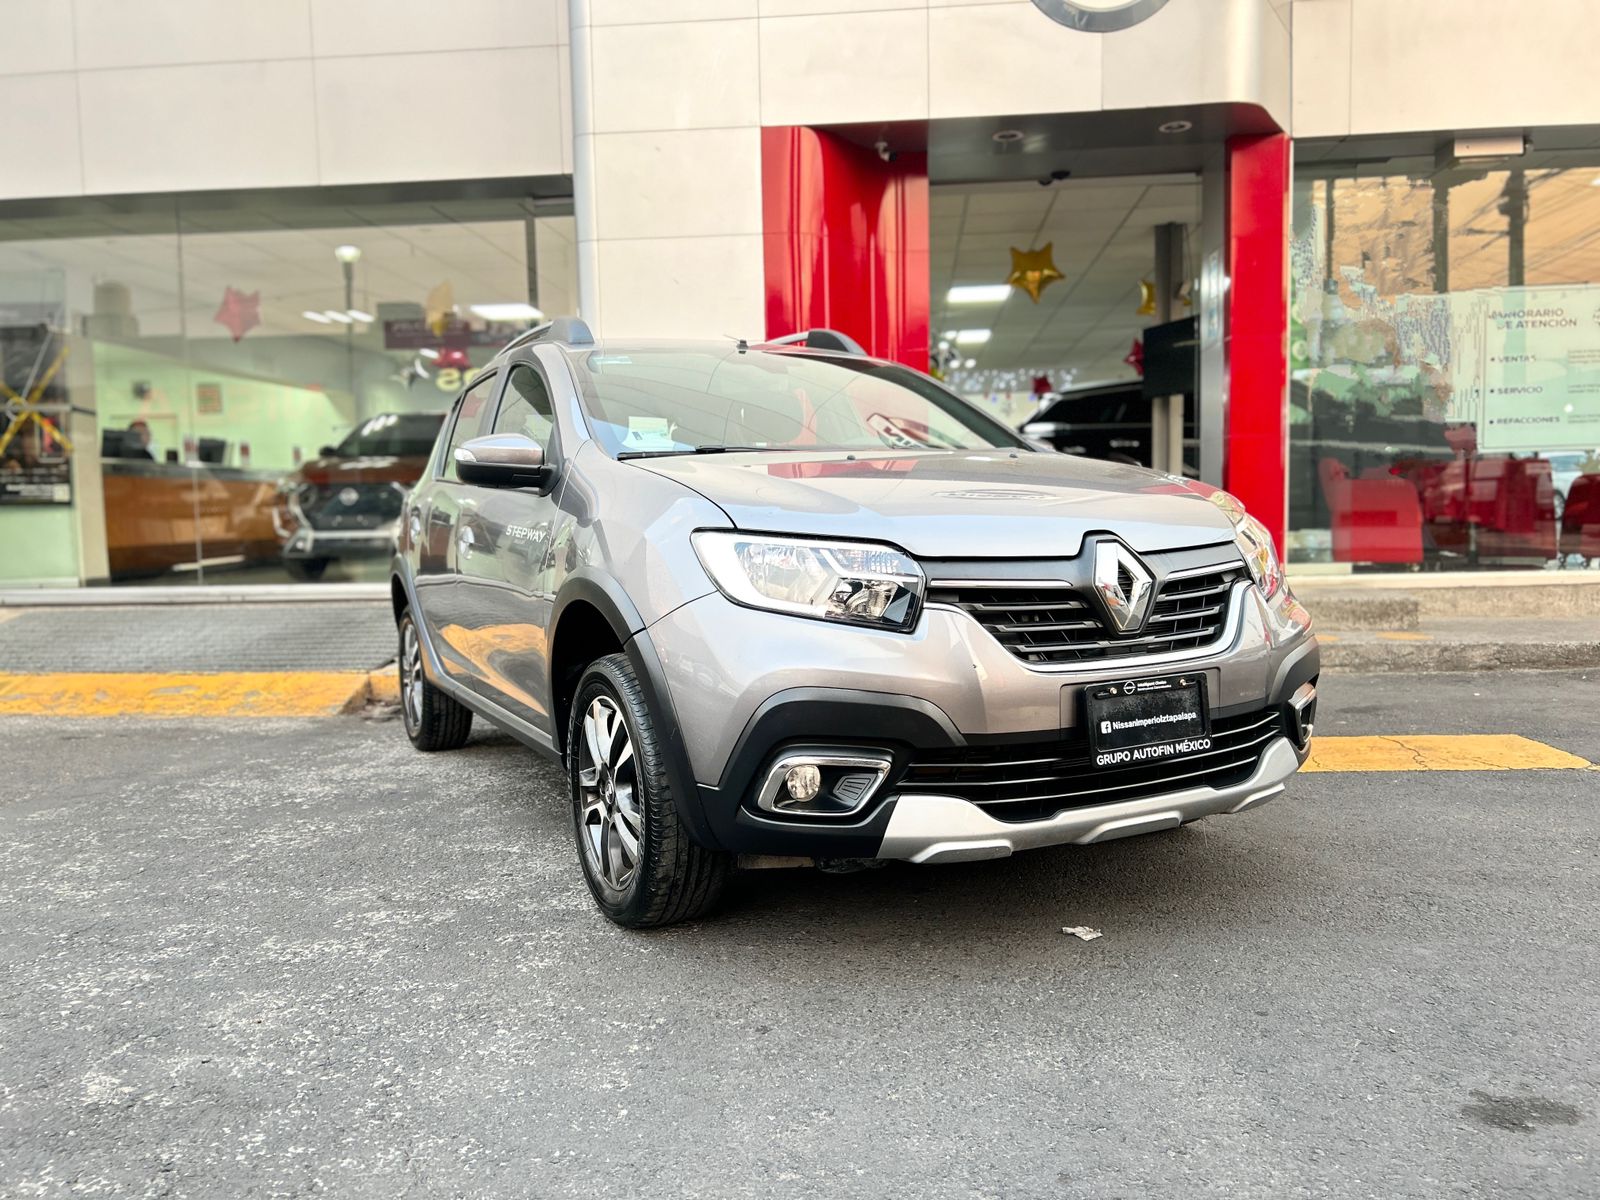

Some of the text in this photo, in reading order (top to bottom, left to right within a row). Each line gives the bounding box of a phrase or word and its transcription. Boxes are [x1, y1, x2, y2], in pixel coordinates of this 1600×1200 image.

[1497, 386, 1543, 394] SERVICIO
[1496, 416, 1560, 424] REFACCIONES
[505, 524, 547, 543] STEPWAY
[1096, 739, 1211, 766] GRUPO AUTOFIN MÉXICO
